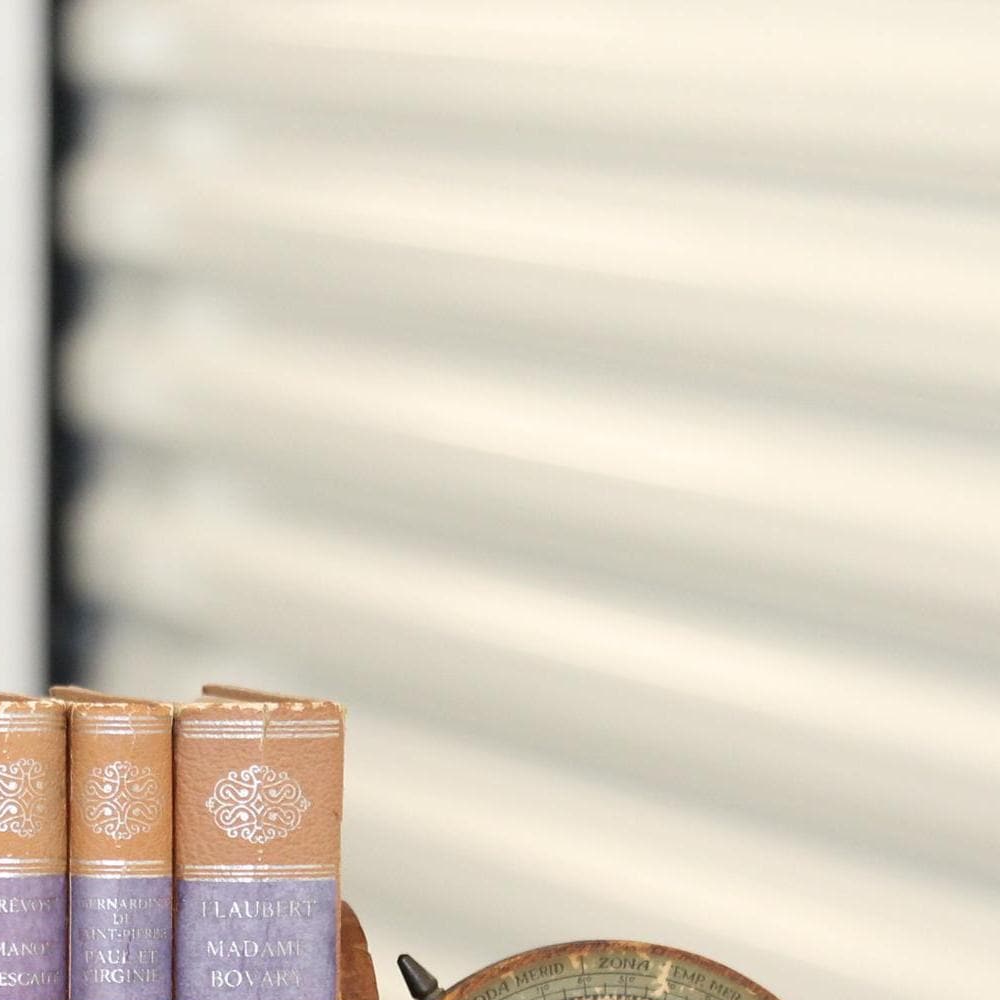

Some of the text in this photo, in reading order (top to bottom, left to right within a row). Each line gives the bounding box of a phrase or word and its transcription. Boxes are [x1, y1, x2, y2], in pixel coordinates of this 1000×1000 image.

[211, 969, 301, 988] BOVARY
[597, 957, 650, 970] ZONA
[668, 964, 706, 986] EMP.
